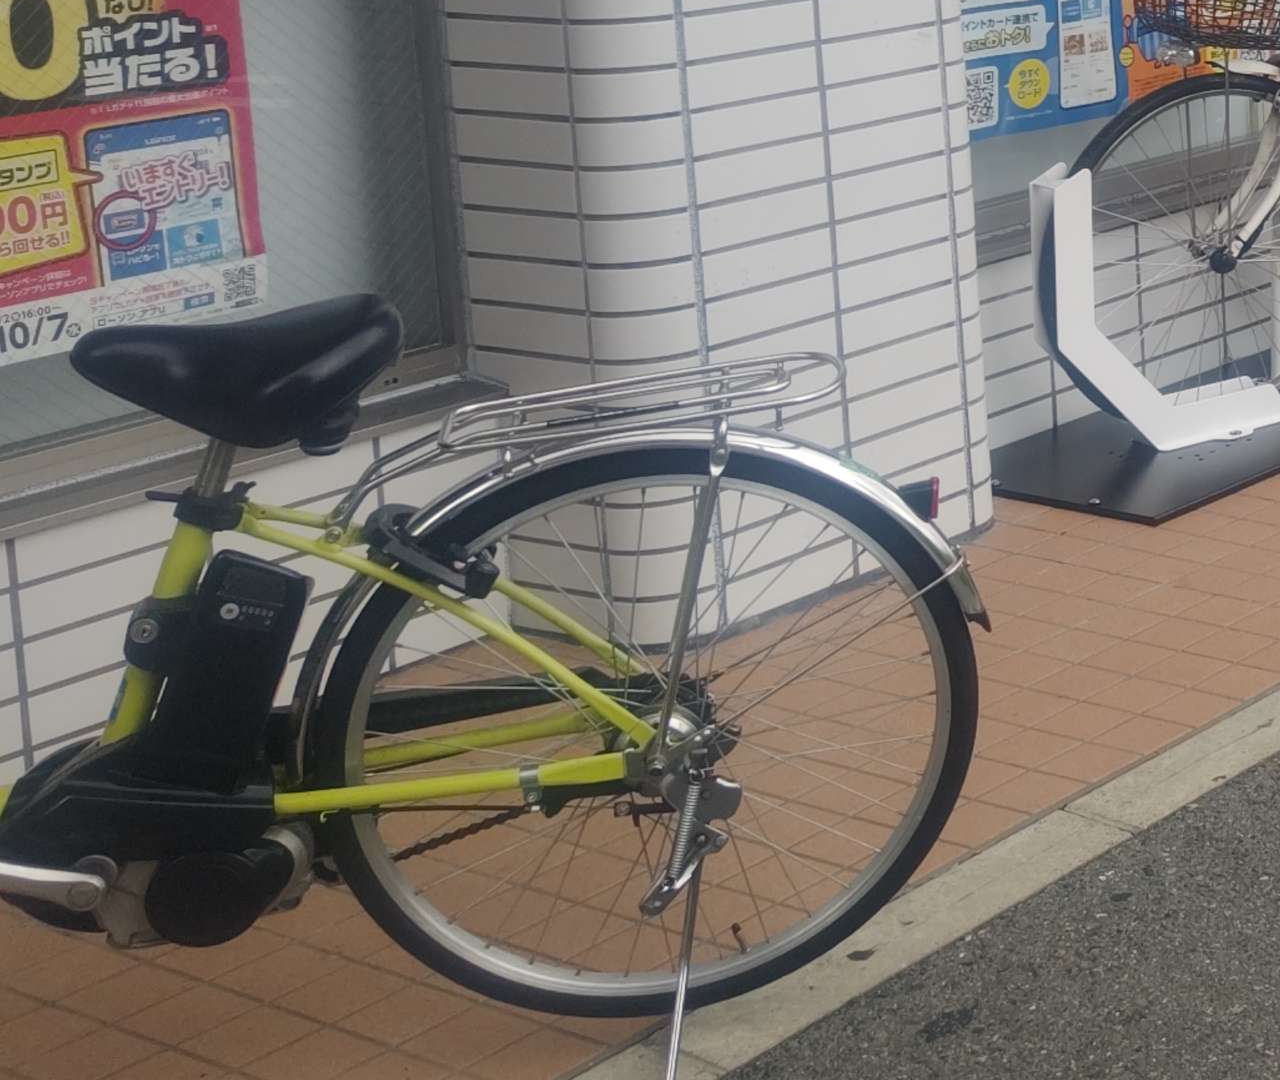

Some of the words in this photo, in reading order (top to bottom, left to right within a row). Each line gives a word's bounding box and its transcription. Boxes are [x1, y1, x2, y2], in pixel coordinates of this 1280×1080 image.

[80, 17, 197, 56] ポイント
[83, 42, 219, 97] 当たる!
